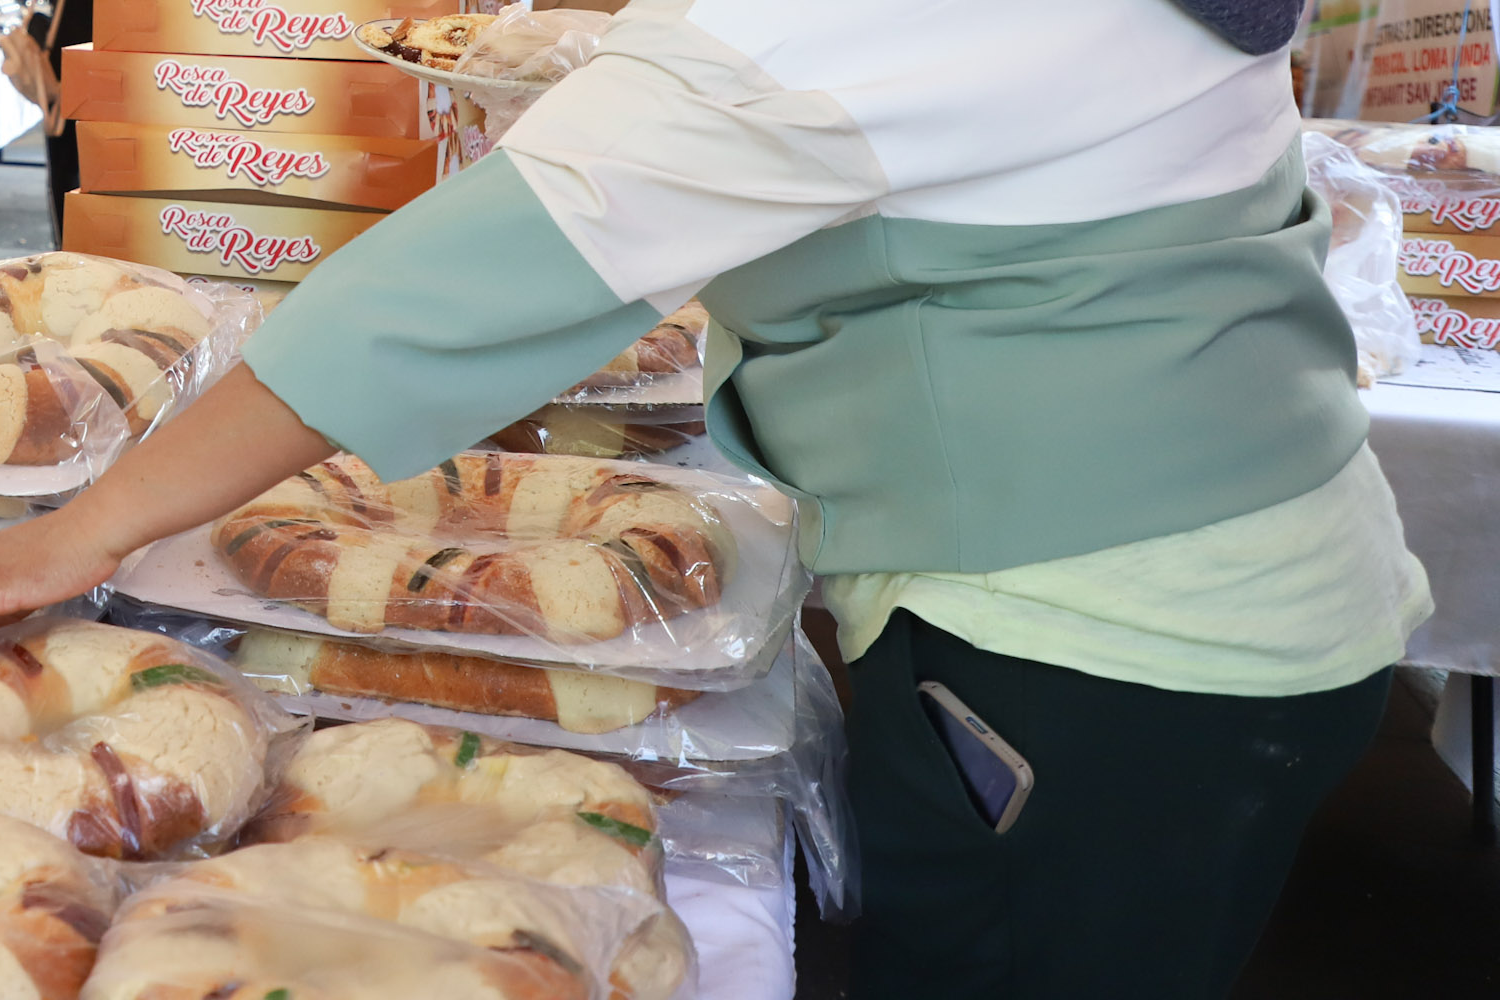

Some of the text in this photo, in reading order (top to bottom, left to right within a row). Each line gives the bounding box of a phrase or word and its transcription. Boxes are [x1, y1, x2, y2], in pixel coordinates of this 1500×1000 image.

[220, 7, 351, 49] de Reyes
[1413, 7, 1493, 40] DIRECCONE
[156, 61, 227, 91] Rosca
[1406, 82, 1431, 105] SAN
[1432, 76, 1477, 105] JGE
[183, 81, 312, 123] de Reyes
[171, 129, 242, 153] Rosca
[196, 141, 328, 182] de Reyes
[163, 206, 232, 236] Rosca
[188, 227, 318, 270] de Reyes
[1402, 240, 1449, 256] osca
[1408, 255, 1433, 272] de
